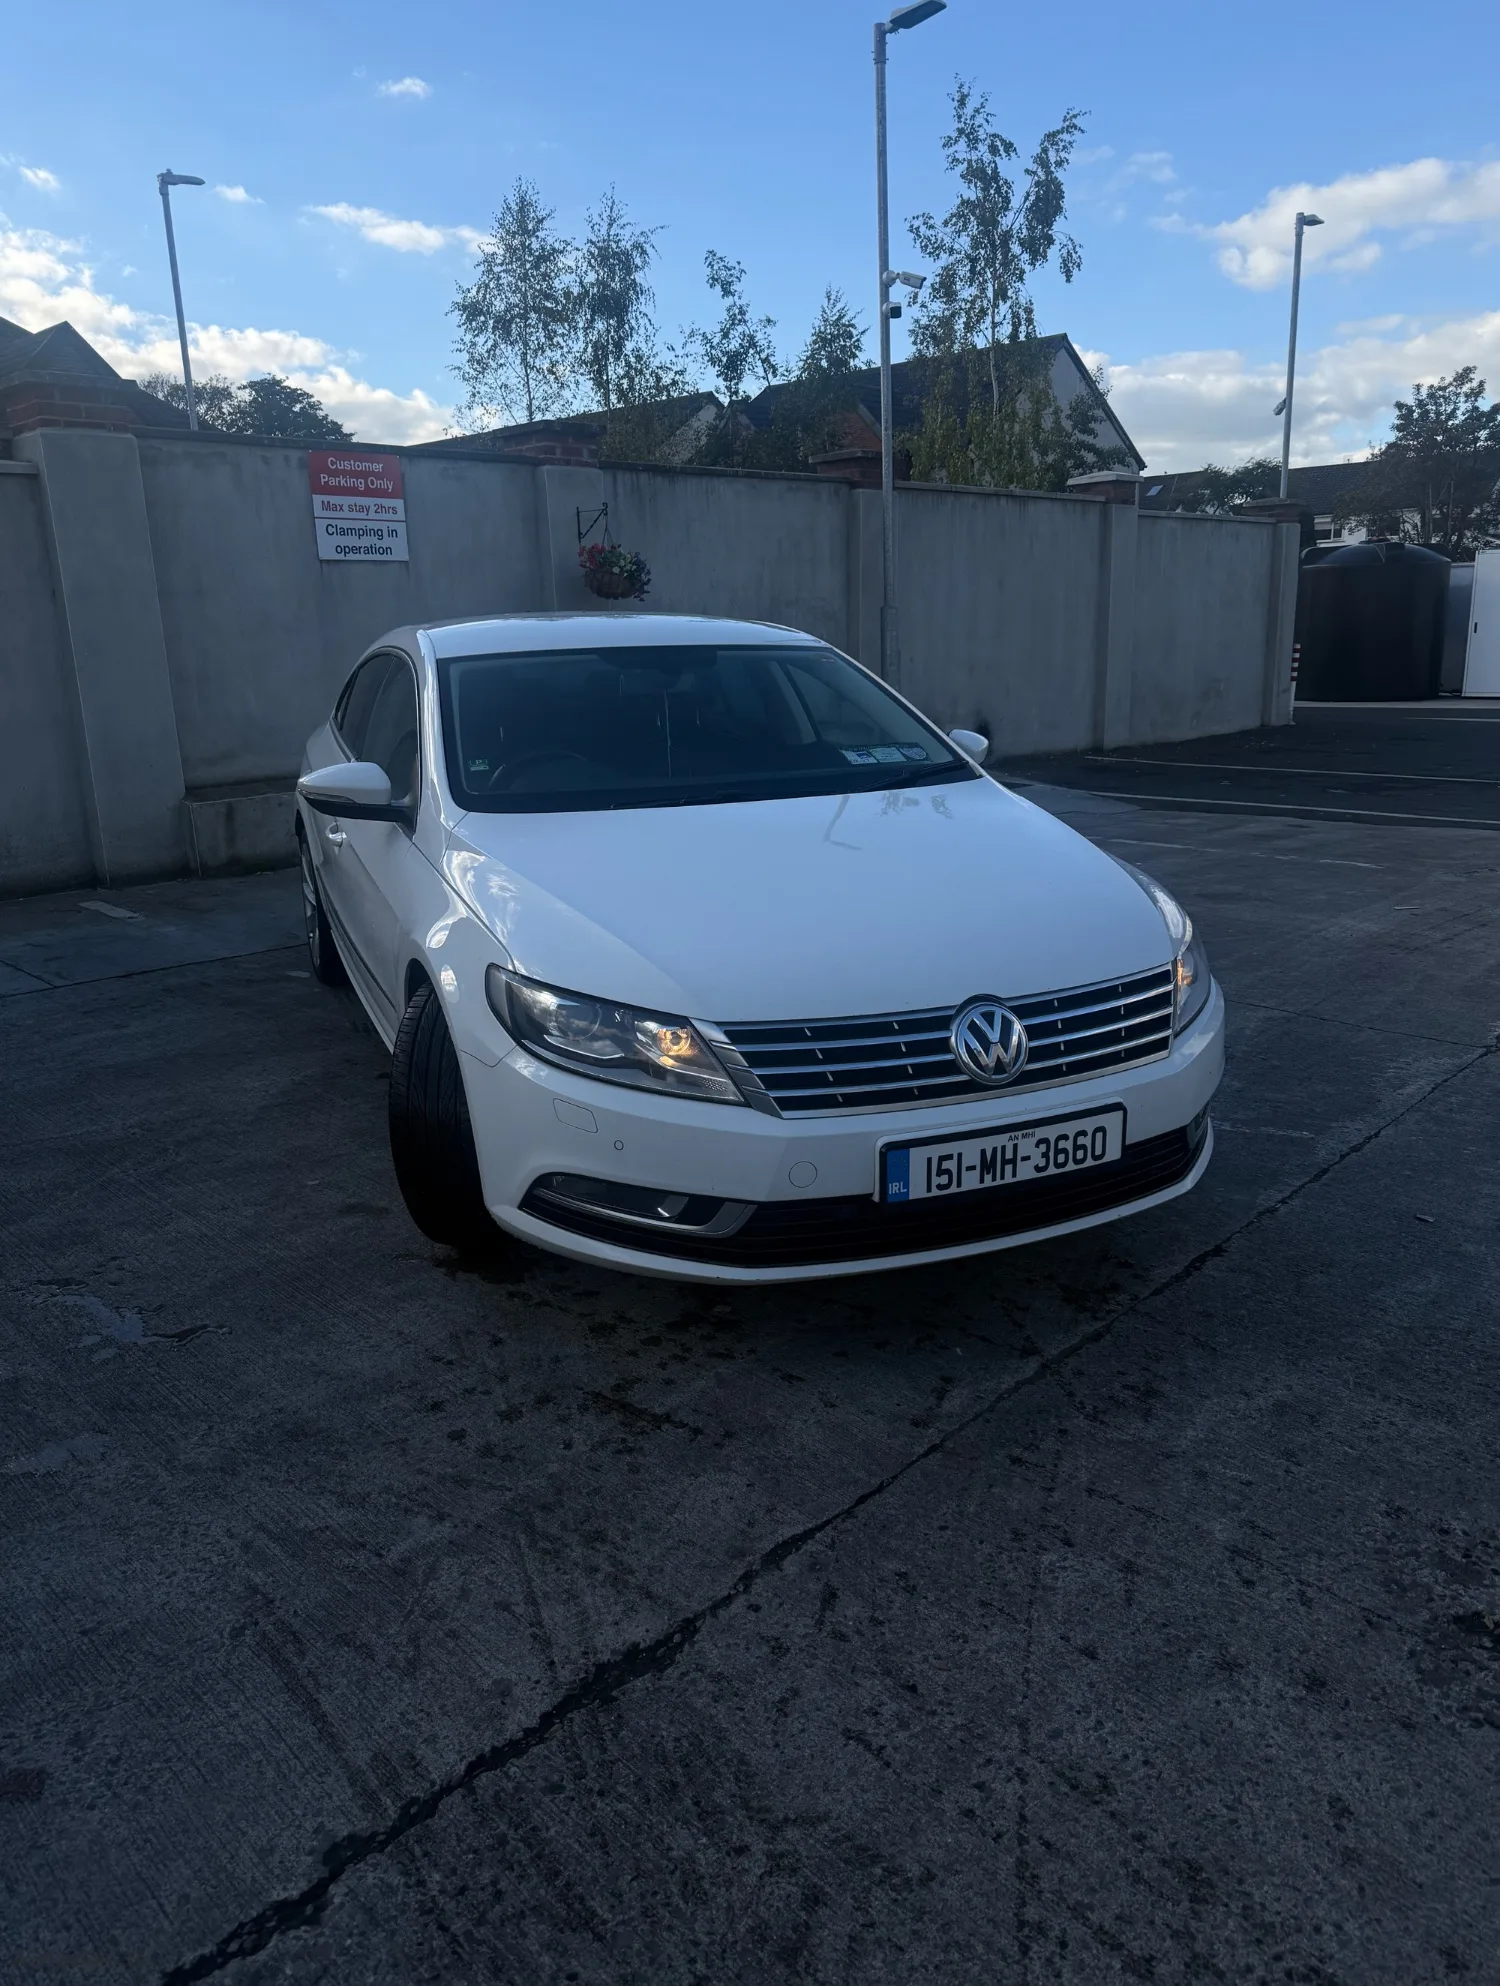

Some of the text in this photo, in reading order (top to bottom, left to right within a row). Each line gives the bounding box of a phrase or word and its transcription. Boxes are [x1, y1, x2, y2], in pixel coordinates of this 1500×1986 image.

[327, 457, 384, 472] Customer
[320, 473, 394, 493] Parking Only
[321, 500, 398, 516] Max stay 2hrs
[325, 523, 399, 541] Clamping in
[335, 543, 393, 558] operation
[1007, 1134, 1020, 1143] AN
[925, 1125, 1108, 1194] 151-MH-3660
[888, 1181, 908, 1195] IRL
